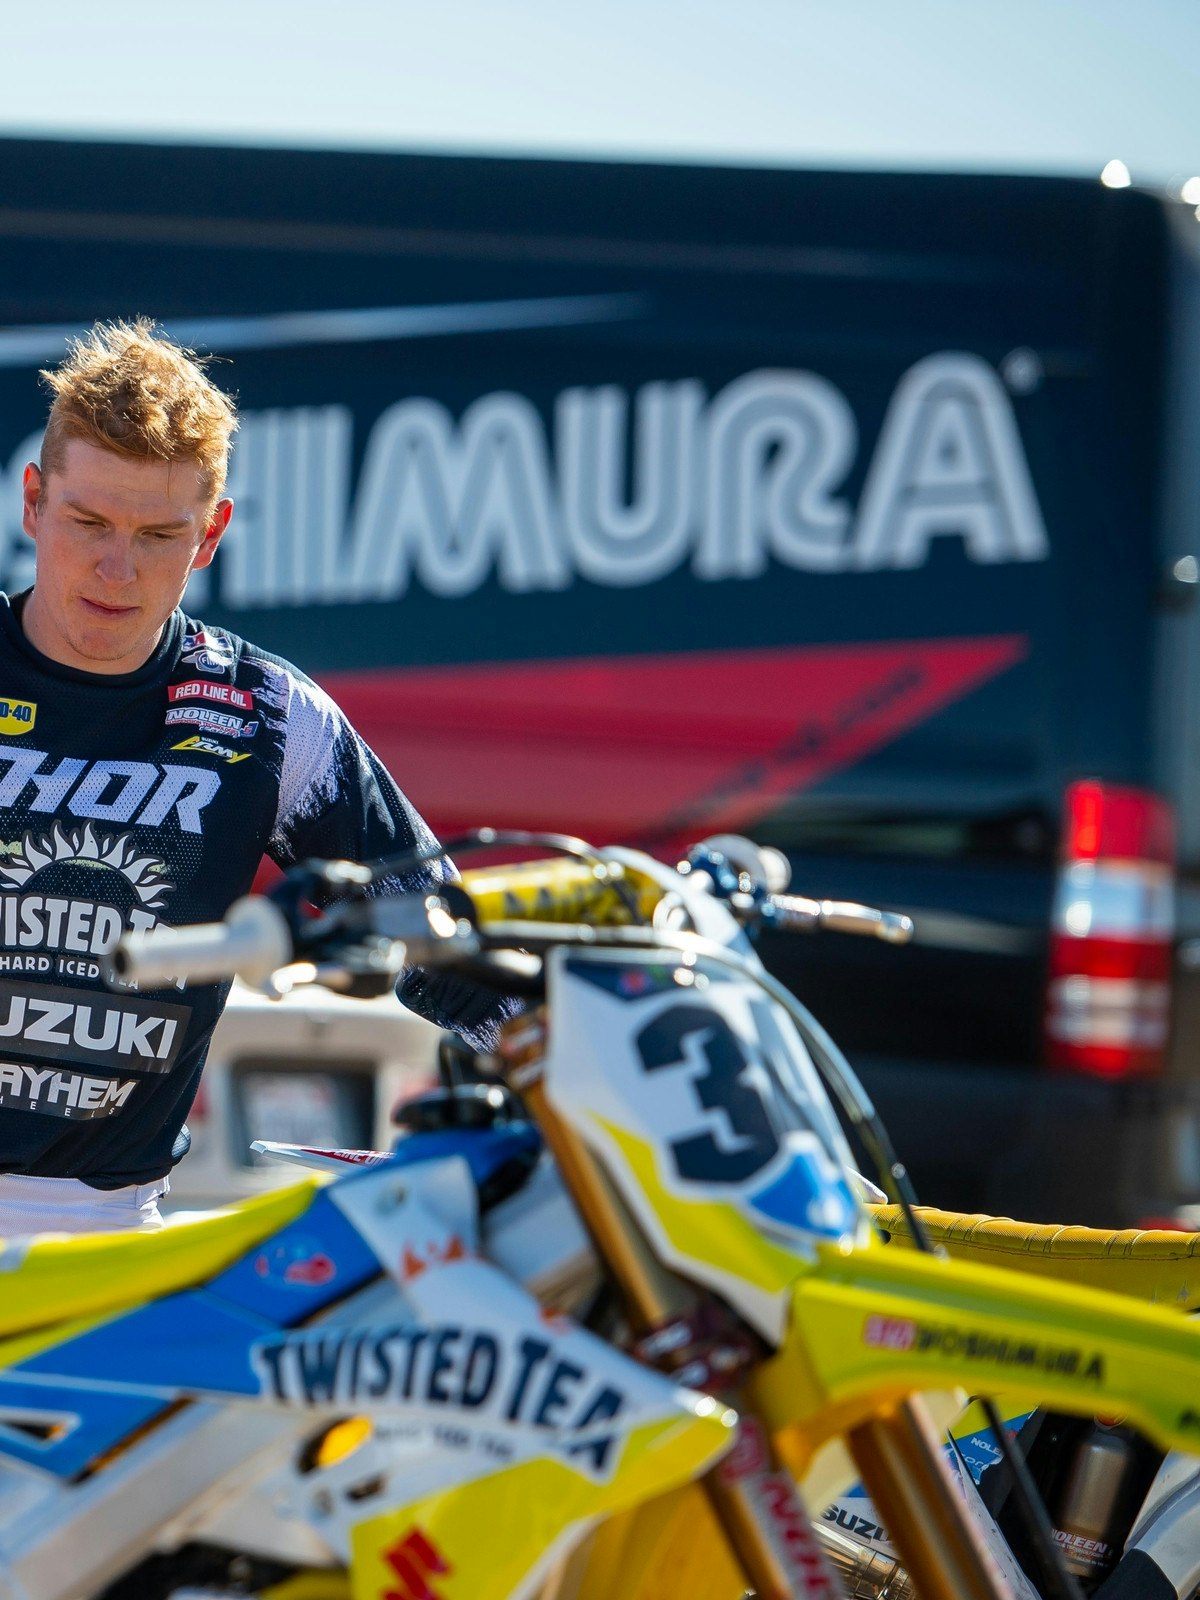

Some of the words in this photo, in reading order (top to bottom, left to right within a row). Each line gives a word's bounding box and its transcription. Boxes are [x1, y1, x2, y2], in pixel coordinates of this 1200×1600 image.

[175, 683, 200, 699] RED
[202, 684, 229, 700] LINE
[230, 690, 246, 707] OIL
[167, 708, 241, 730] NOLEEN
[59, 959, 100, 978] ICED
[636, 1003, 780, 1183] 3
[260, 1328, 499, 1409] TWISTED
[506, 1336, 626, 1471] TEA
